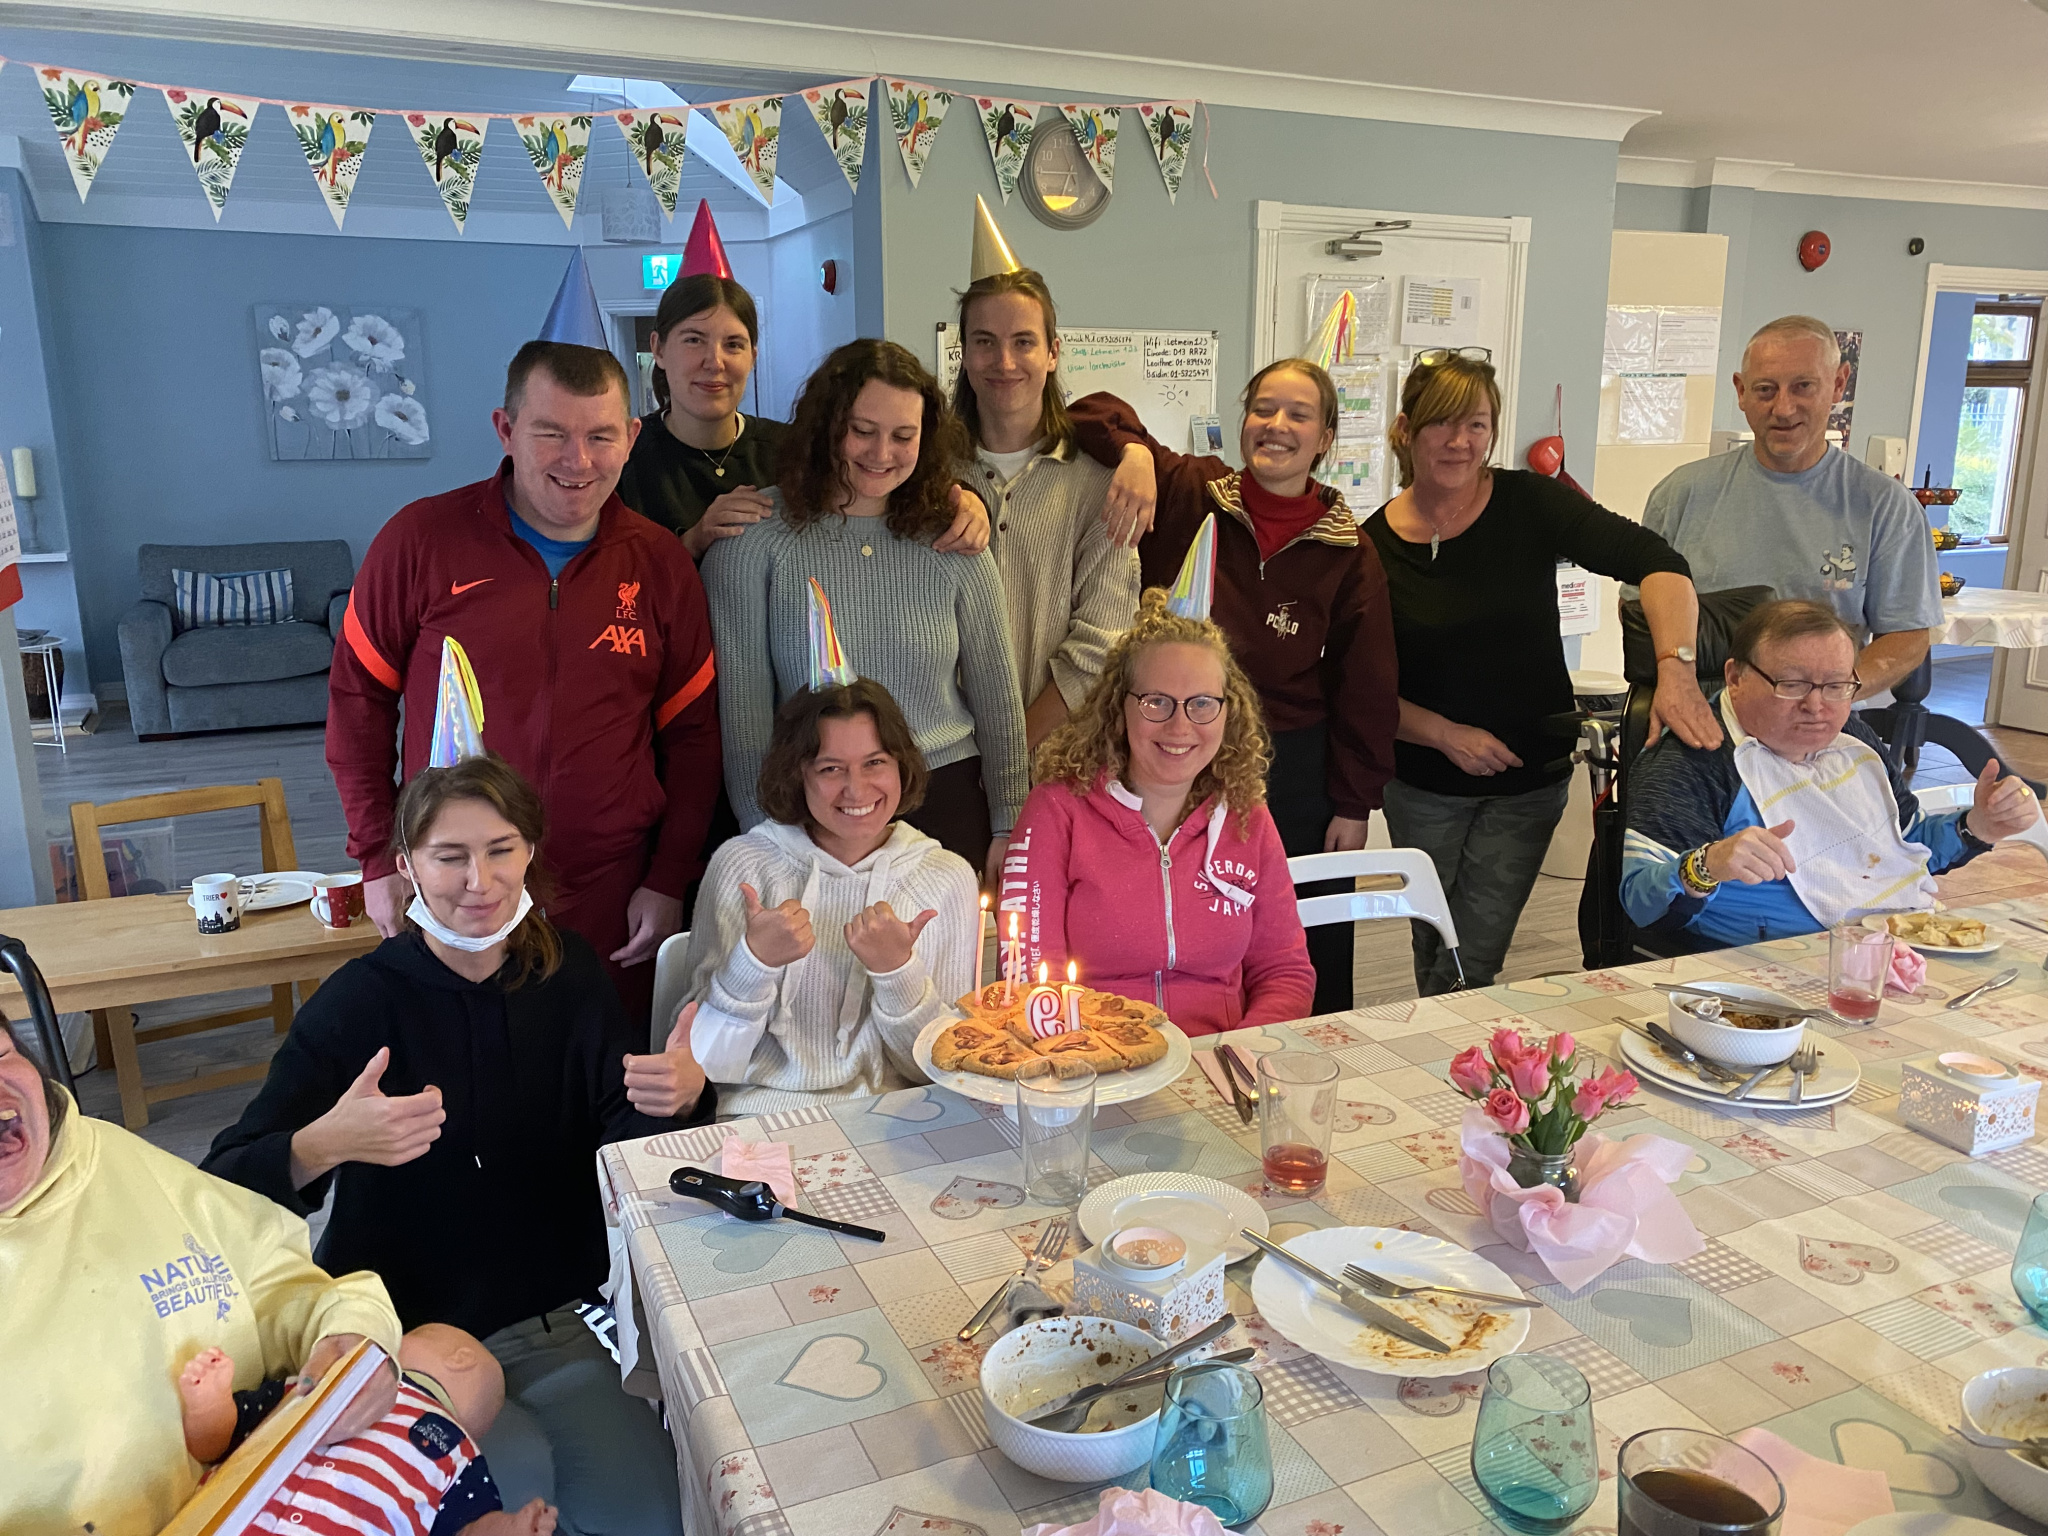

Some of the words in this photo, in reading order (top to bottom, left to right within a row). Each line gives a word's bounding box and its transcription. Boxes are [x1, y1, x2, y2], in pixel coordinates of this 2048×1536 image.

[1041, 150, 1053, 161] 10
[1146, 336, 1161, 349] Wifi
[616, 610, 637, 620] LFC
[588, 624, 647, 657] AXA
[1194, 859, 1258, 892] SUPERDR
[203, 893, 220, 901] TRIER
[139, 1254, 230, 1293] NATUE
[150, 1282, 188, 1303] BRINGS
[189, 1277, 200, 1288] US
